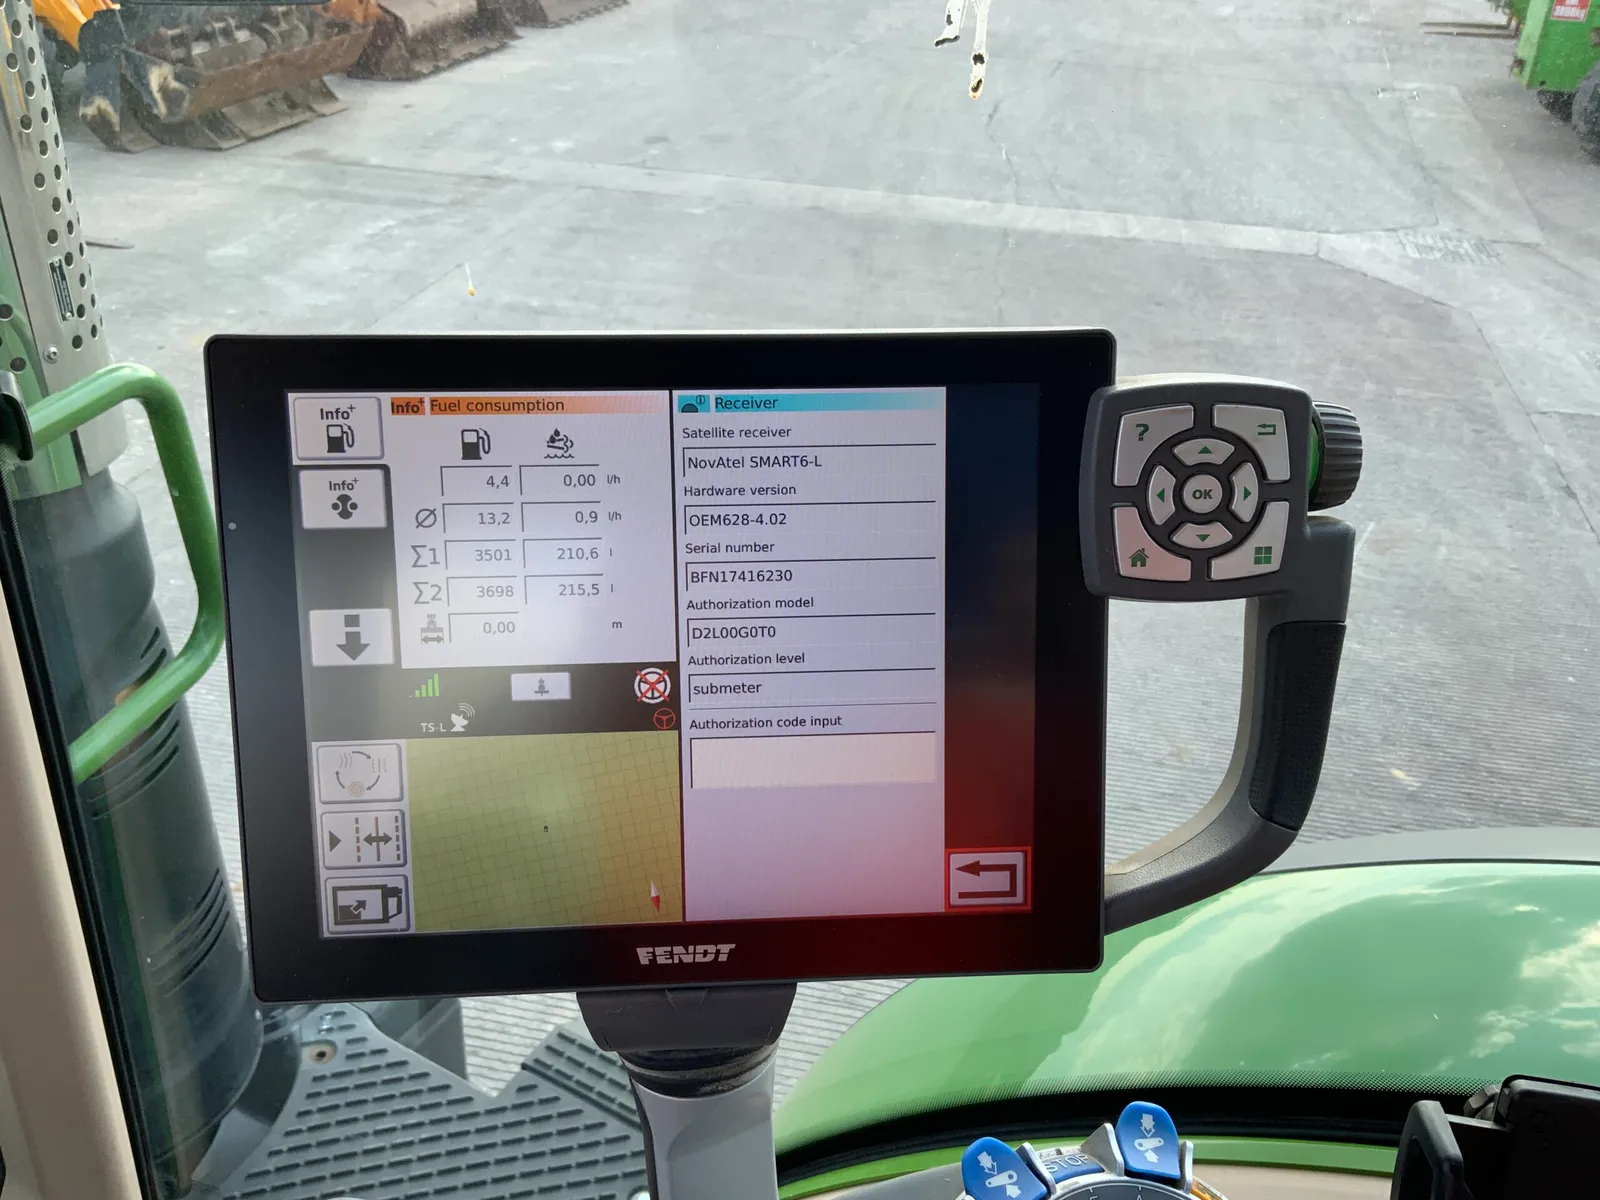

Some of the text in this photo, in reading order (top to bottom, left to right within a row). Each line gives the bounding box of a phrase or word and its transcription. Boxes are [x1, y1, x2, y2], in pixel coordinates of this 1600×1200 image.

[430, 399, 565, 413] Fuel consumption
[715, 397, 778, 410] Receiver
[682, 427, 791, 439] Satellite receiver
[688, 455, 822, 469] NovAtel SMART6-L
[486, 475, 510, 488] 4,4
[563, 474, 620, 488] 0,00 l/h
[684, 485, 796, 497] Hardware version
[1192, 489, 1213, 500] OK
[478, 512, 510, 526] 13,2
[575, 511, 622, 525] 0,9 l/h
[689, 513, 787, 526] OEM628-4.02
[557, 548, 599, 561] 210,6
[685, 542, 775, 554] Serial number
[475, 548, 512, 562] 3501
[691, 570, 793, 583] BFN17416230
[476, 585, 514, 598] 3698
[558, 584, 600, 598] 215,5
[687, 597, 814, 610] Authorization model
[483, 621, 515, 635] 0,00
[612, 620, 622, 629] m
[688, 653, 805, 665] Authorization level
[693, 683, 762, 695] submeter
[420, 722, 447, 733] TS-L
[690, 716, 842, 729] Authorization code input
[636, 944, 736, 965] FENDT
[1044, 1154, 1088, 1173] STOP
